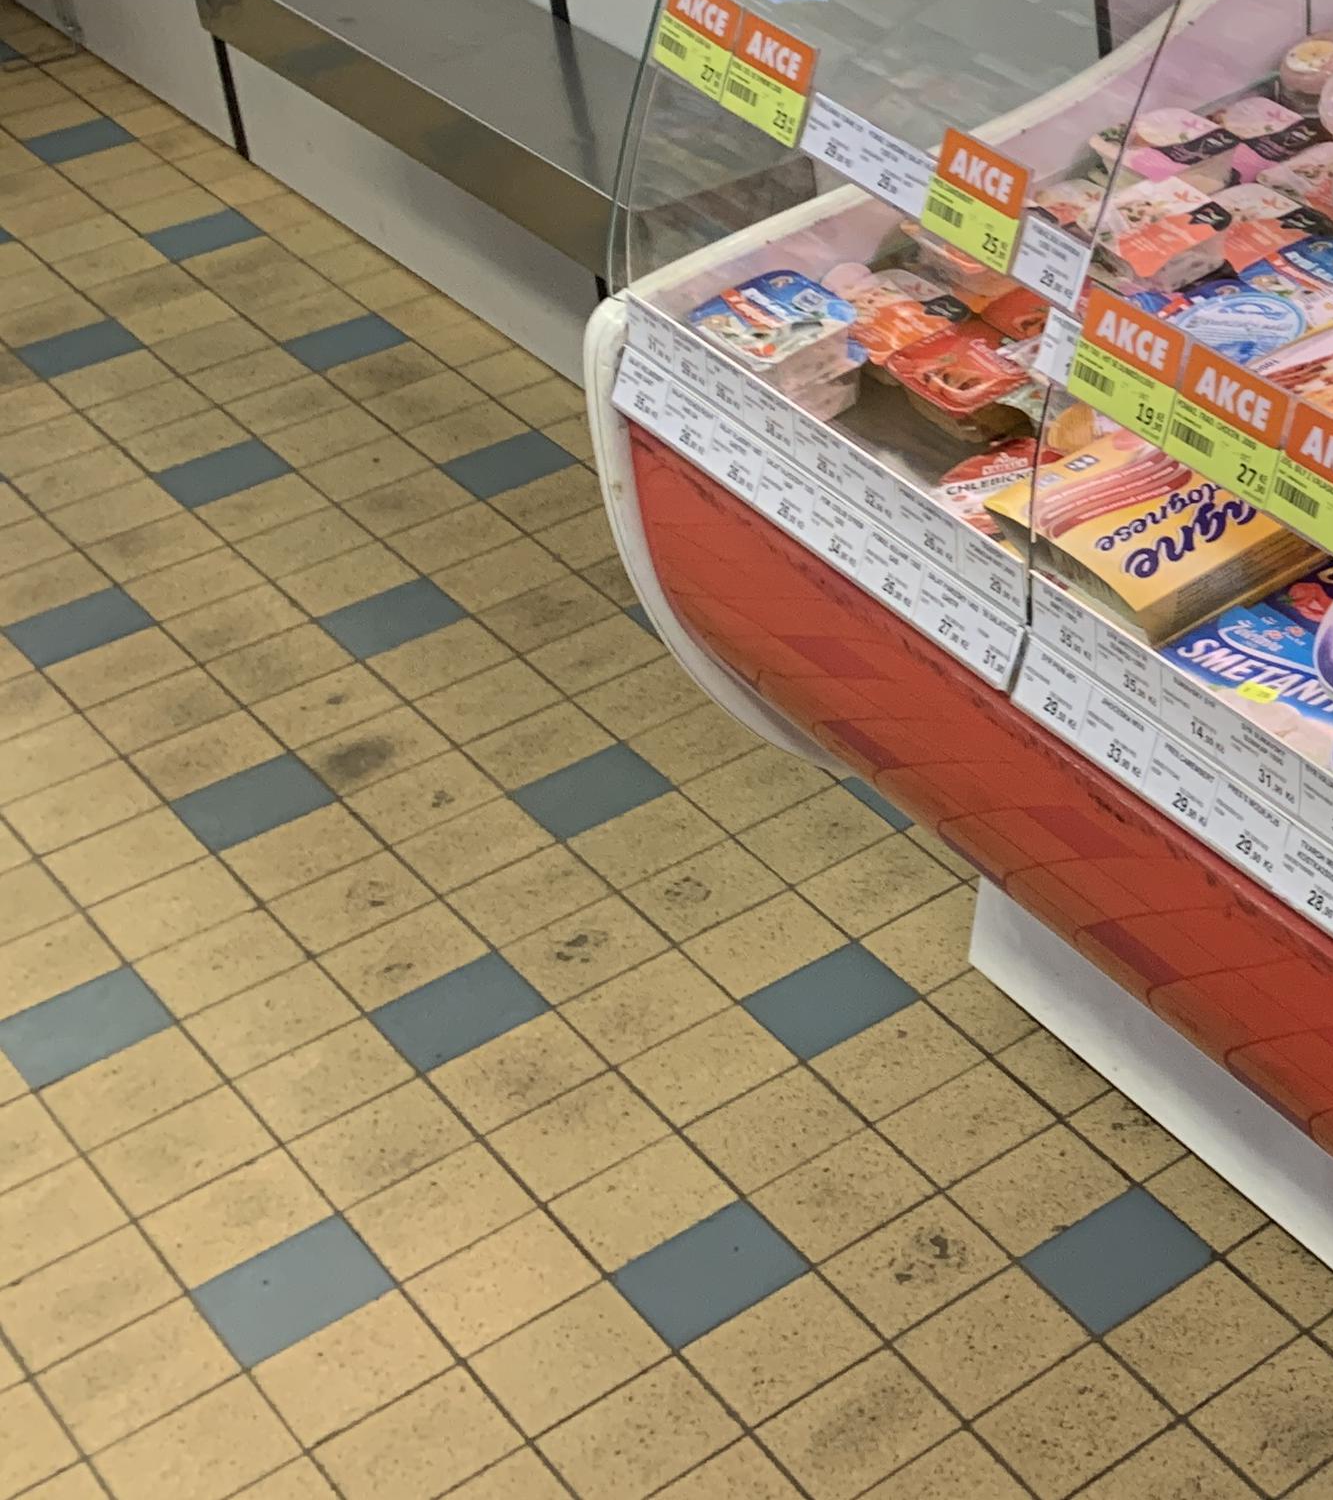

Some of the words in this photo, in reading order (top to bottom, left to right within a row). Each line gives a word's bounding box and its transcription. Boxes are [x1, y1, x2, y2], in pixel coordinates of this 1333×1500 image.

[746, 29, 802, 83] AKCE
[948, 148, 1014, 206] AKCE
[1096, 310, 1169, 370] AKCE
[1193, 366, 1272, 433] AKCE
